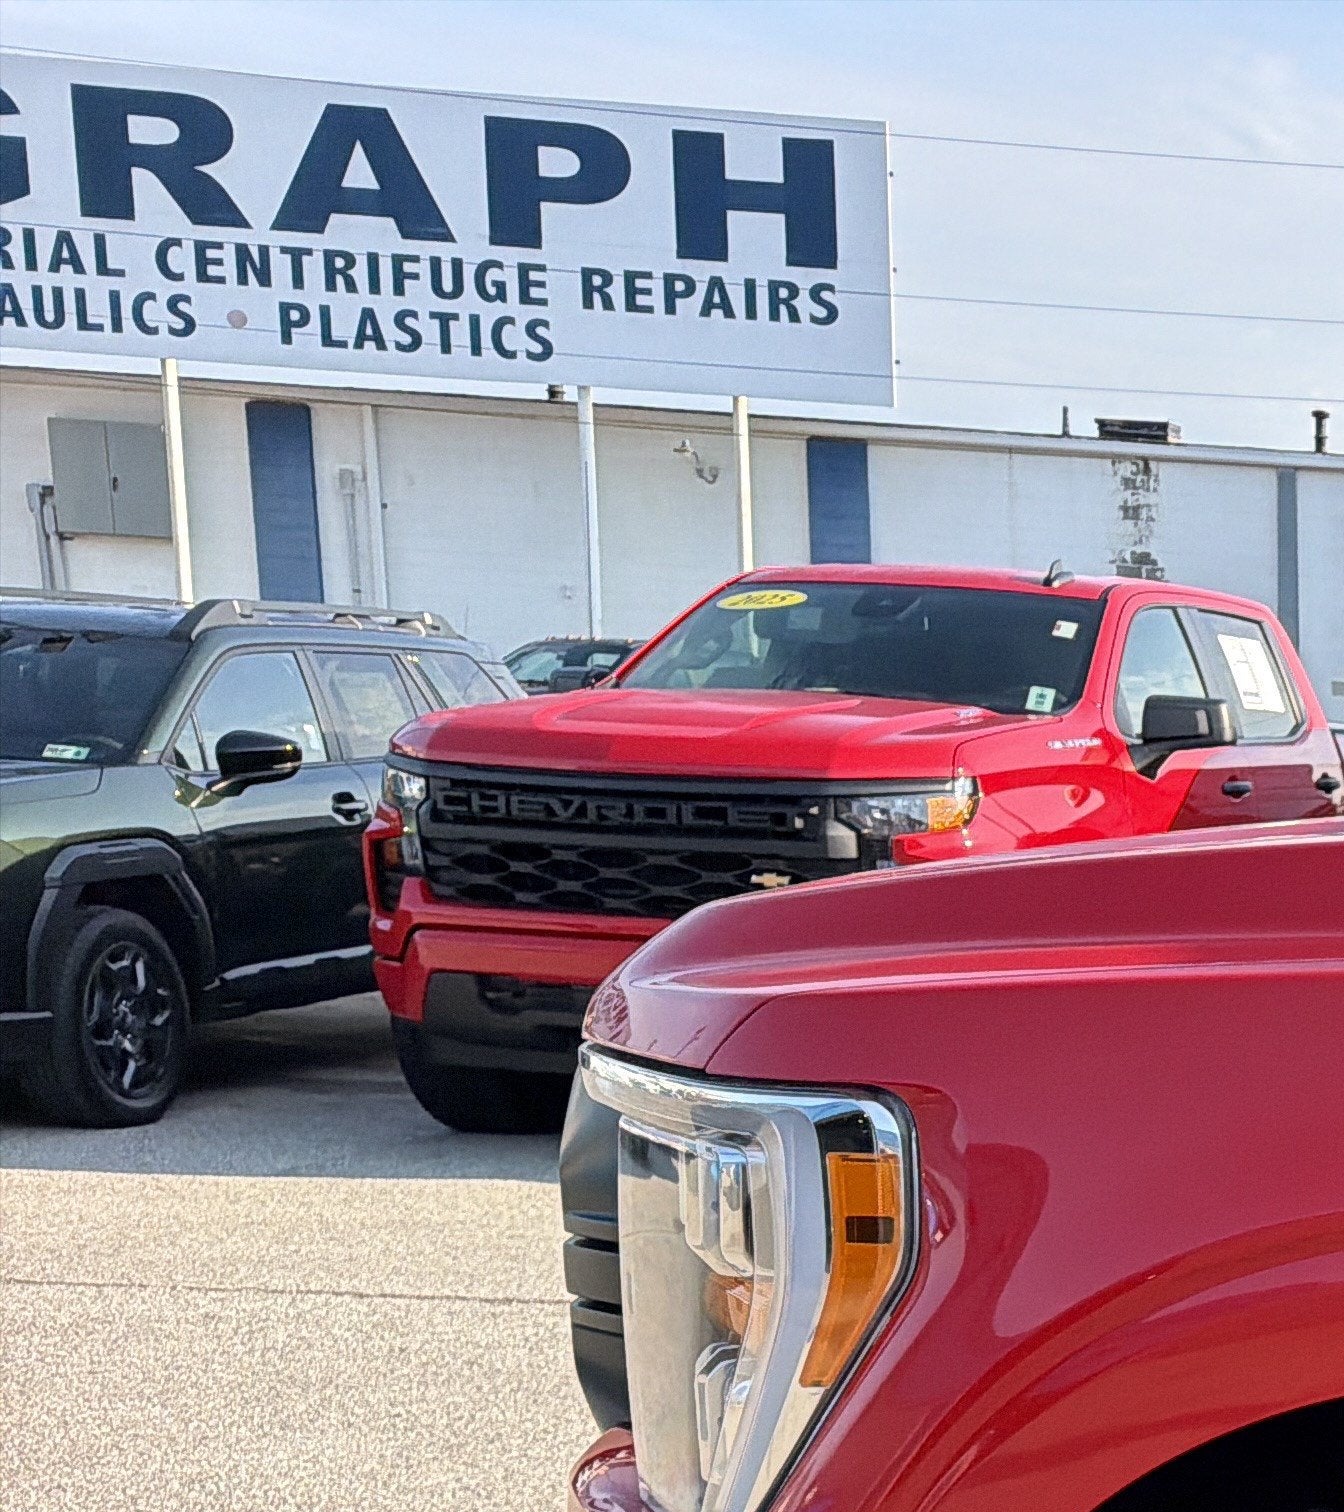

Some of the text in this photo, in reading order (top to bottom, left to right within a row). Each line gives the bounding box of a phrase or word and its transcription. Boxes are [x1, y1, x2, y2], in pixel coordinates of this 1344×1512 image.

[0, 83, 839, 271] RAPH
[155, 237, 549, 307] CENTRIFUGE
[581, 267, 839, 326] REPAIRS
[0, 283, 554, 363] AULICS PLASTICS
[727, 593, 797, 607] 2025
[435, 788, 812, 832] CHEVROLET
